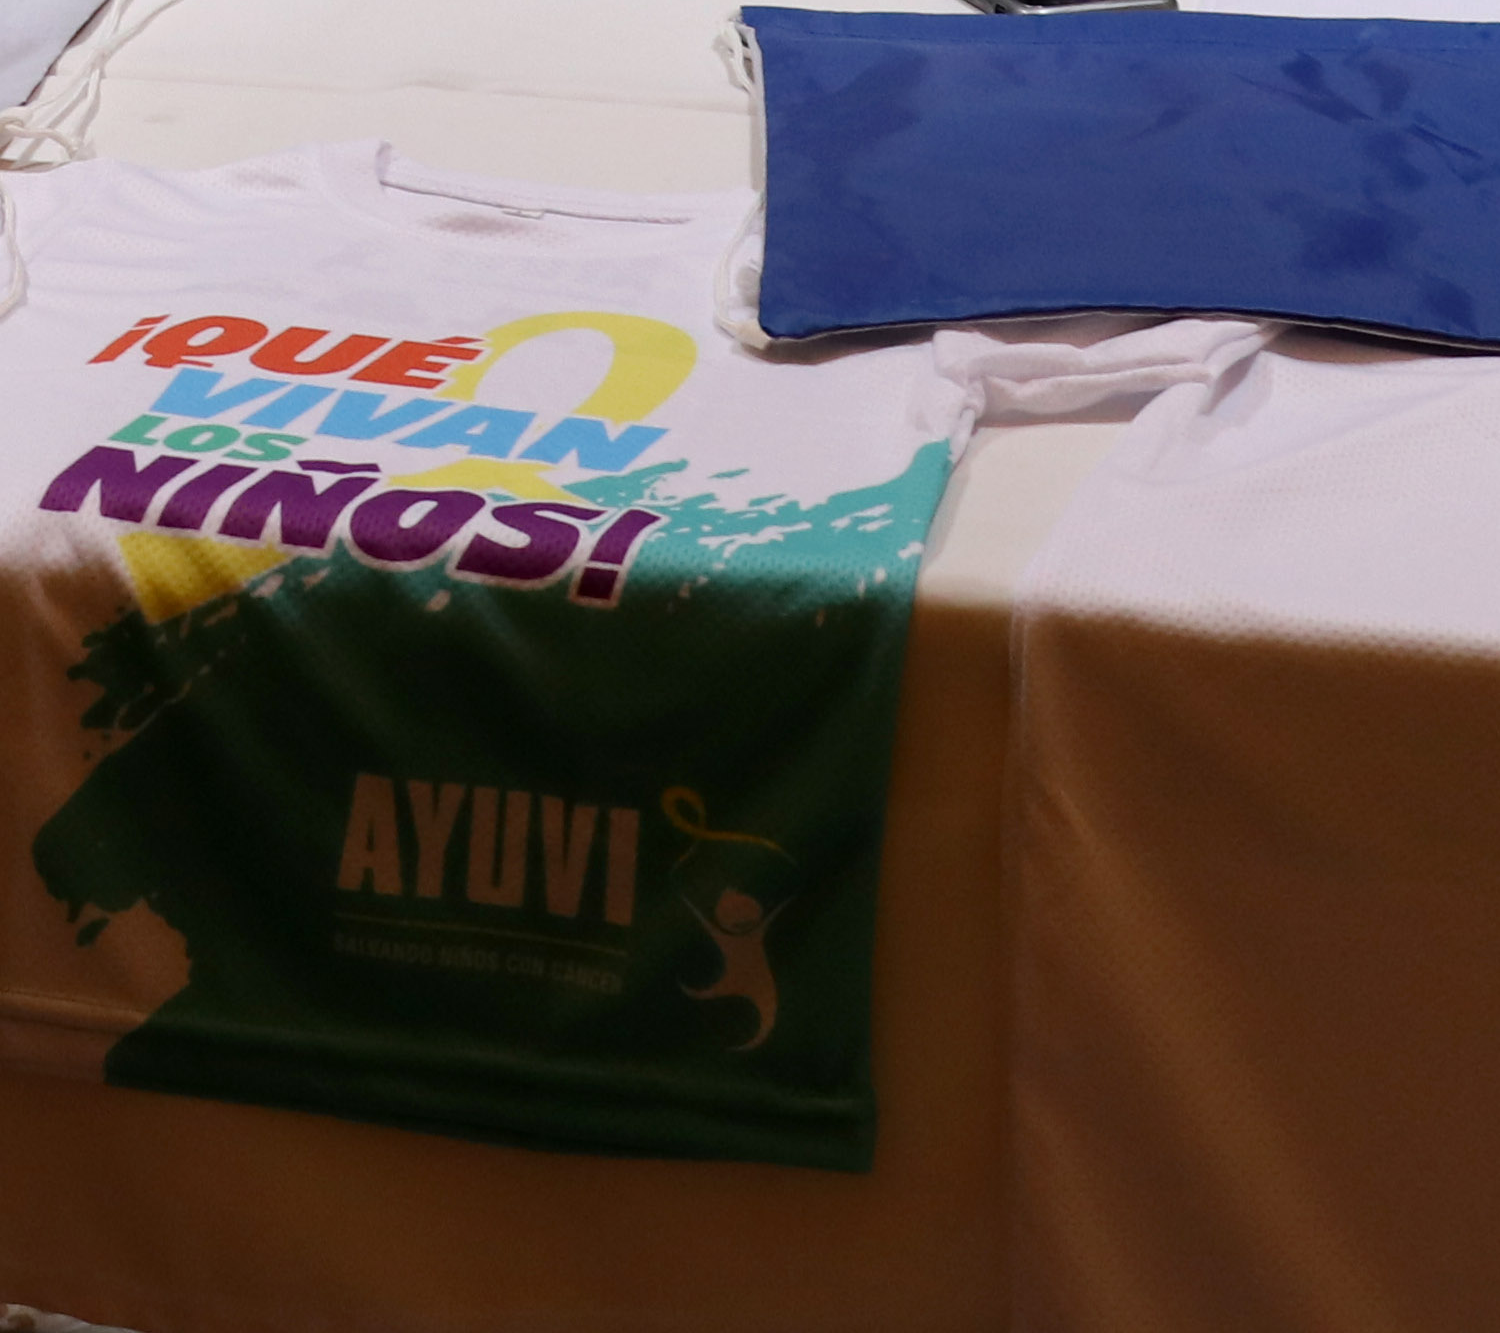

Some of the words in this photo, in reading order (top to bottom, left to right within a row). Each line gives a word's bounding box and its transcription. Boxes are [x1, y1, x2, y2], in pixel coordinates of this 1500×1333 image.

[86, 313, 487, 390] ¡QUÉ
[110, 414, 309, 462] LOS
[148, 367, 670, 474] VIVAN
[38, 445, 666, 604] NIÑOS!
[337, 772, 641, 928] AYUVI
